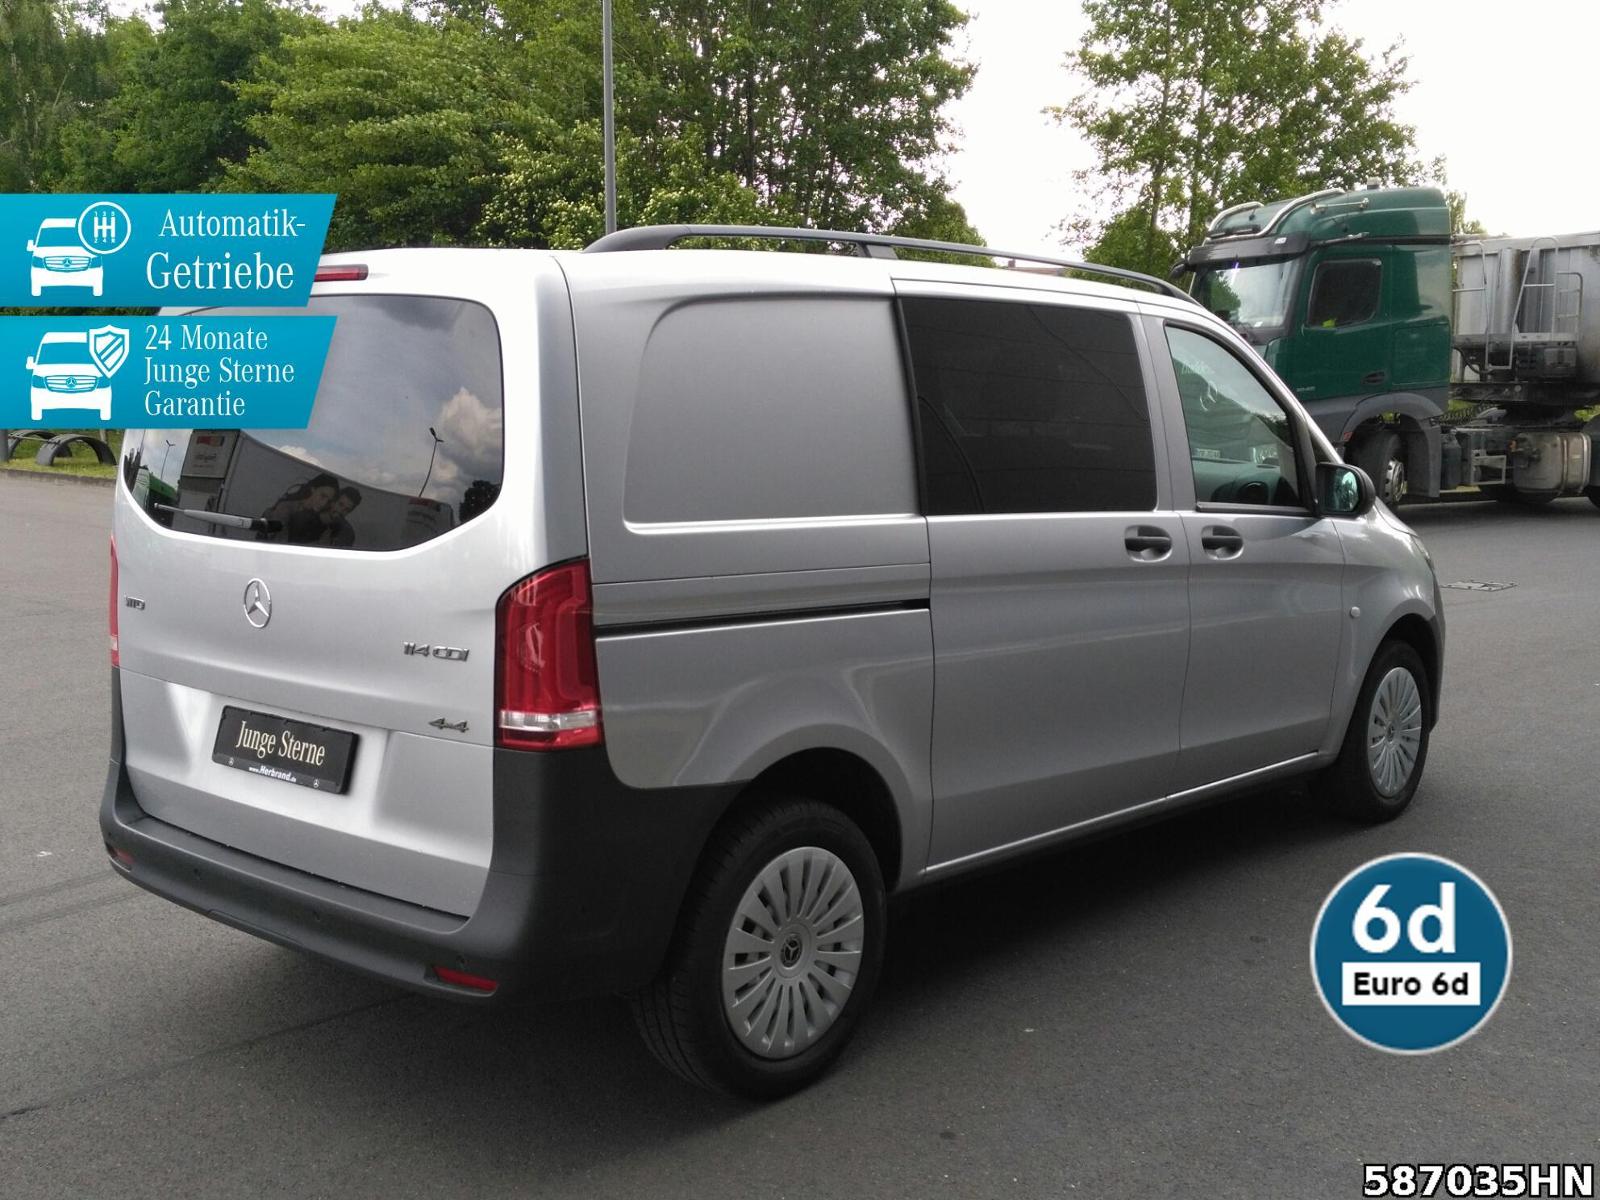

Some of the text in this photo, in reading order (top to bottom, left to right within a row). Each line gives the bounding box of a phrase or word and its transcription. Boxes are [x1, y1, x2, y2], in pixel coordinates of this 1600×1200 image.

[403, 642, 469, 662] 114 CDI
[236, 720, 325, 766] Junge Sterne
